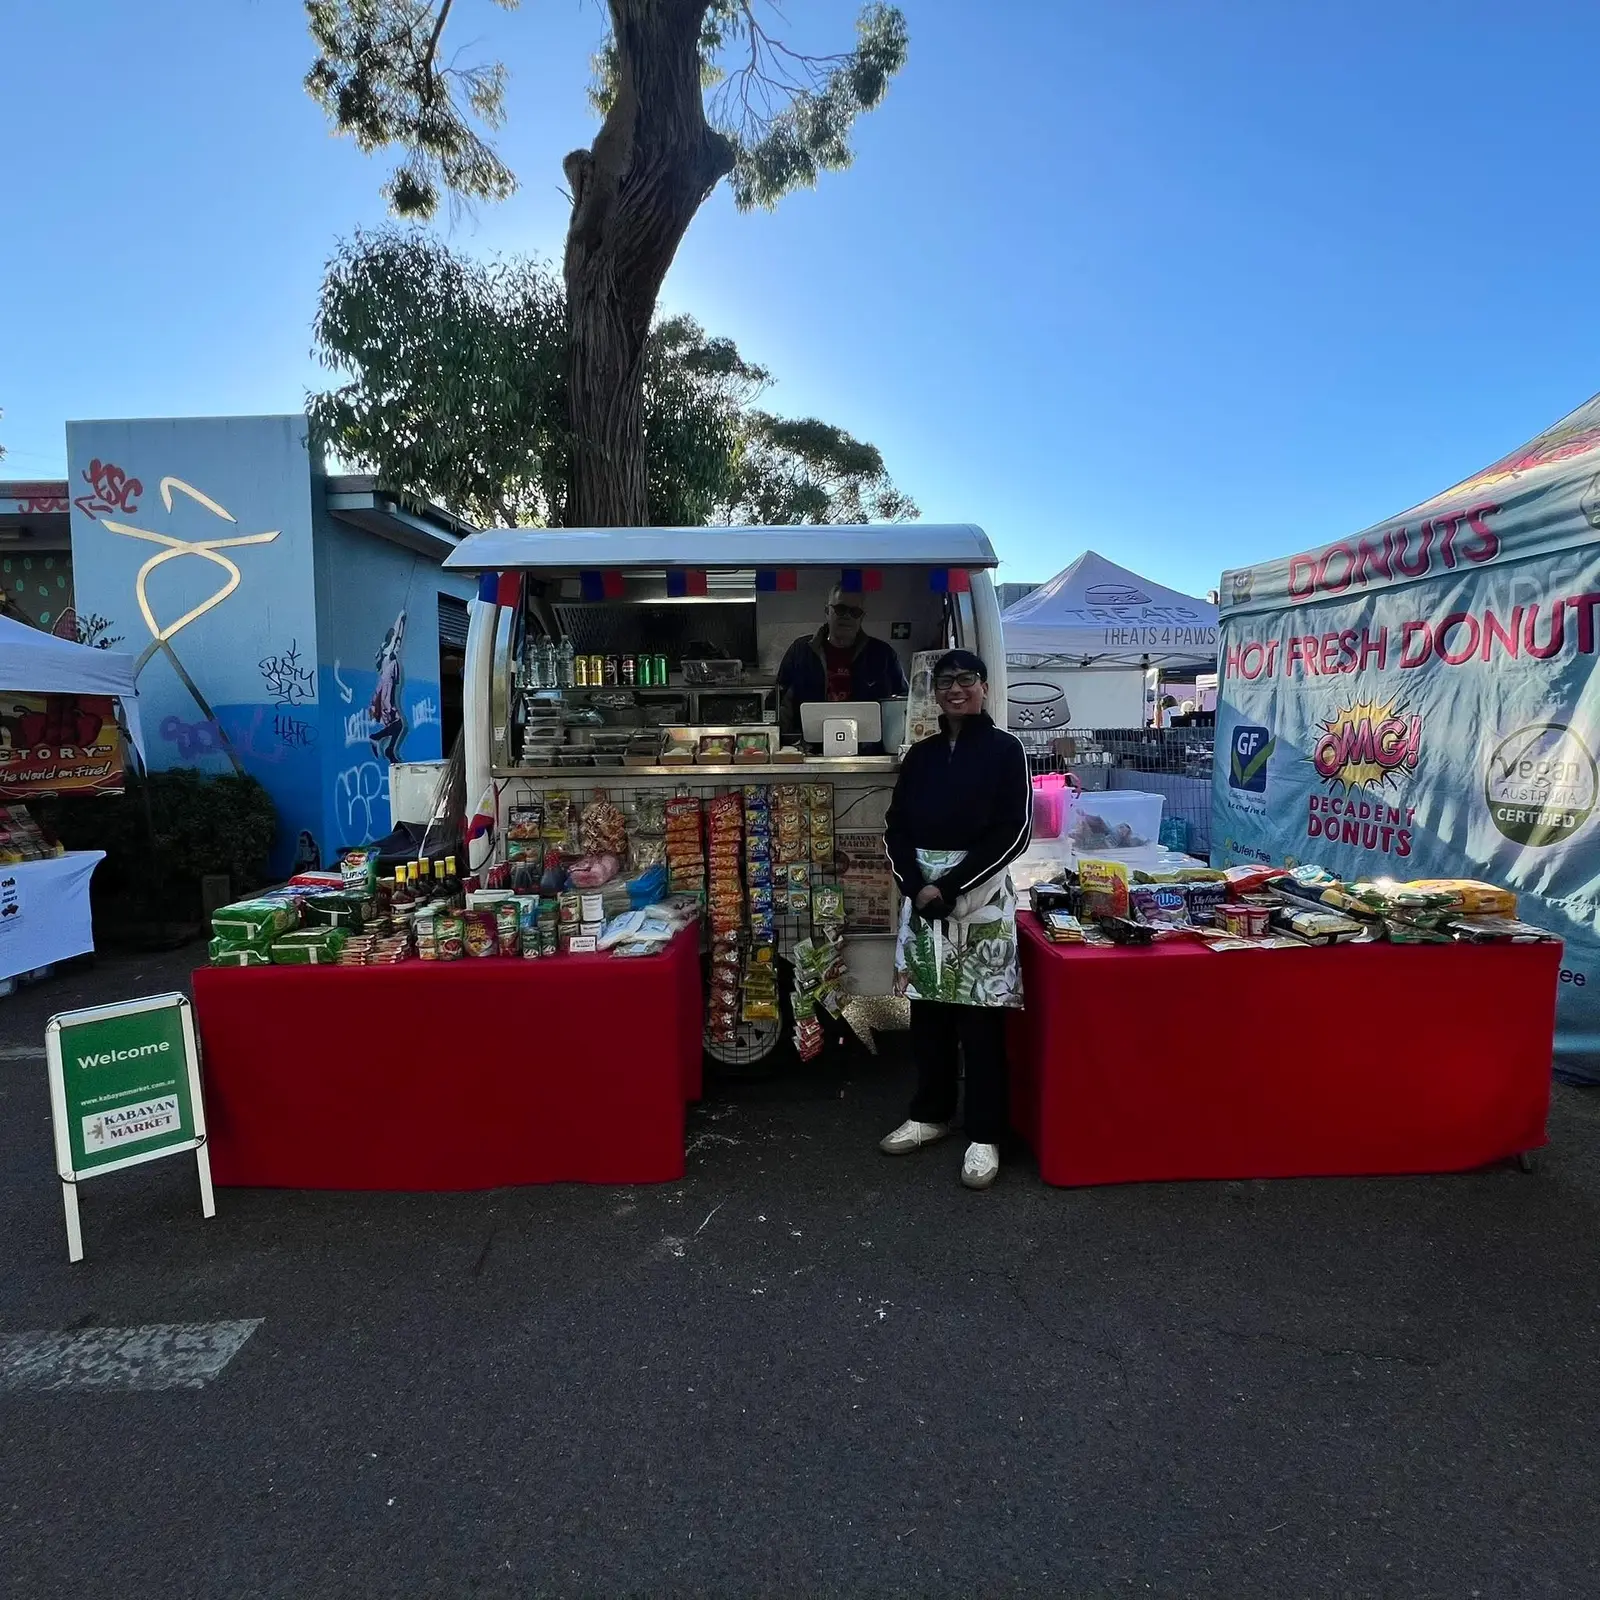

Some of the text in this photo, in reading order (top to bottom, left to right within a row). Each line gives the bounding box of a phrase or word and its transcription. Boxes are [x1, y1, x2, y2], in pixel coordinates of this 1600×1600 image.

[1287, 502, 1503, 602] DONUTS
[1103, 627, 1216, 646] TREATS 4 PAWS
[1226, 593, 1600, 680] HOT FRESH DONUT
[1237, 732, 1260, 755] GF
[1314, 714, 1422, 778] OMG!
[20, 765, 56, 781] World
[58, 770, 73, 778] on
[75, 761, 111, 776] Fire!
[1309, 795, 1415, 827] DECADENT
[1496, 808, 1576, 828] CERTIFIED
[1308, 814, 1413, 858] DONUTS
[1255, 848, 1271, 863] Free
[1152, 892, 1184, 907] Ube
[77, 1041, 170, 1069] Welcome
[80, 1079, 175, 1106] www.kabayanmarket.com.au
[104, 1100, 175, 1126] KABAYAN
[110, 1115, 173, 1139] MARKET
